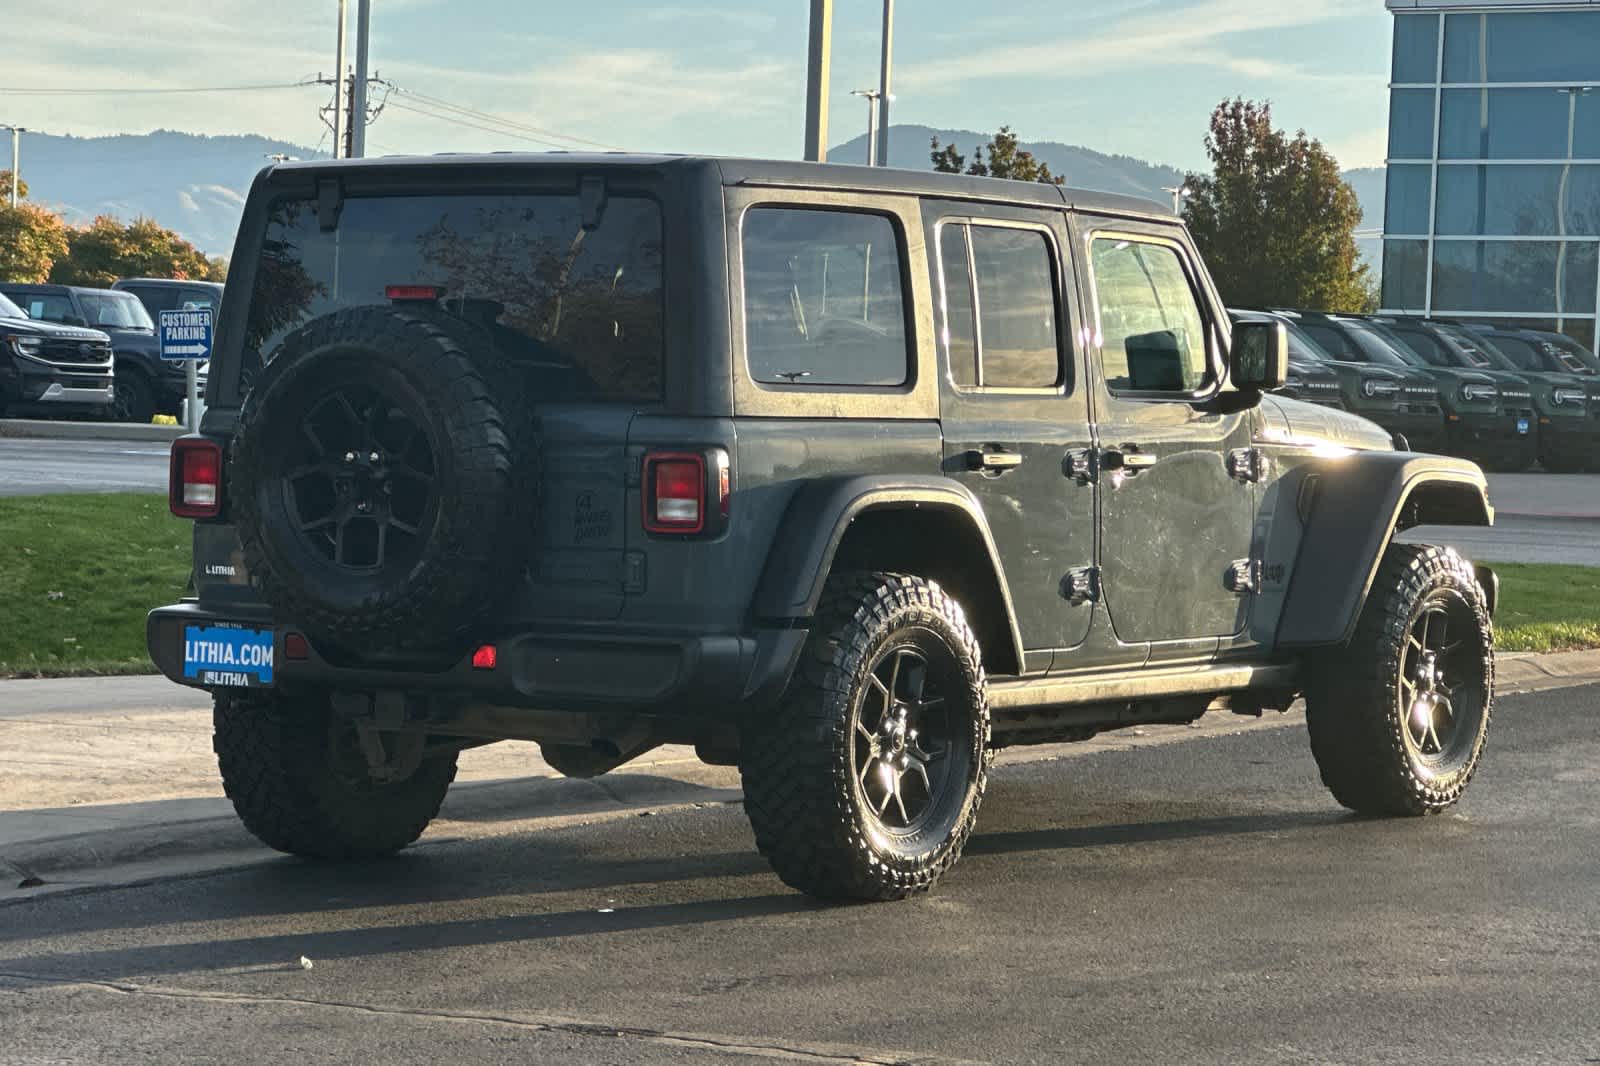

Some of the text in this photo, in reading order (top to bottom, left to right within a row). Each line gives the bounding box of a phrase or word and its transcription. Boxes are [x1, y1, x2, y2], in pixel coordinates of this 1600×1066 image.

[161, 313, 210, 327] CUSTOMER
[166, 327, 206, 340] PARKING
[185, 640, 273, 667] LITHIA.COM
[214, 671, 249, 687] LITHIA
